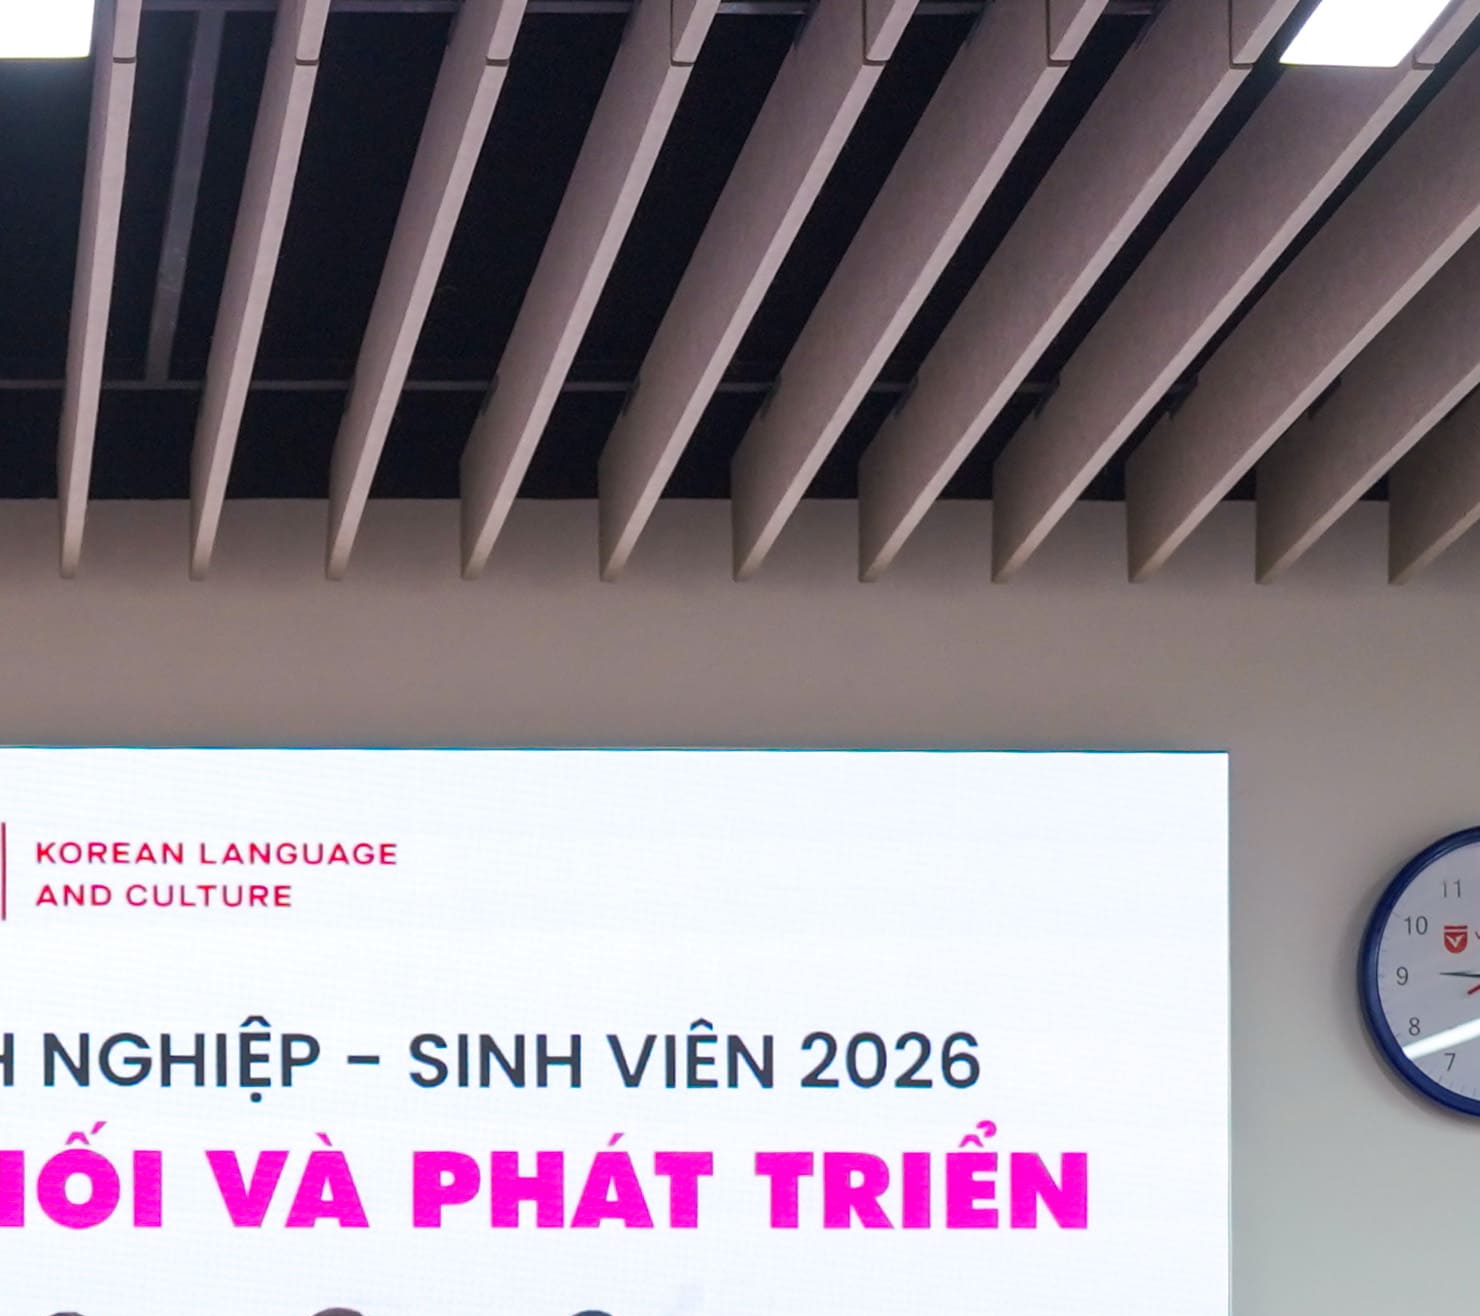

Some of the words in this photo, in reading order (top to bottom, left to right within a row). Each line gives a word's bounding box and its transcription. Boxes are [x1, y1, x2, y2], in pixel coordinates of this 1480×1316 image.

[37, 842, 183, 864] KOREAN
[200, 843, 397, 865] LANGUAGE
[36, 884, 111, 906] AND
[126, 884, 291, 907] CULTURE
[1404, 916, 1428, 935] 10
[1397, 966, 1408, 986] 9
[1409, 1017, 1420, 1036] 8
[43, 1015, 320, 1103] NGHIỆP
[410, 1034, 581, 1088] SINH
[606, 1018, 773, 1089] VIÊN
[801, 1031, 980, 1089] 2026
[205, 1133, 369, 1228] VÀ
[413, 1133, 713, 1228] PHÁT
[755, 1120, 1088, 1229] TRIỂN
